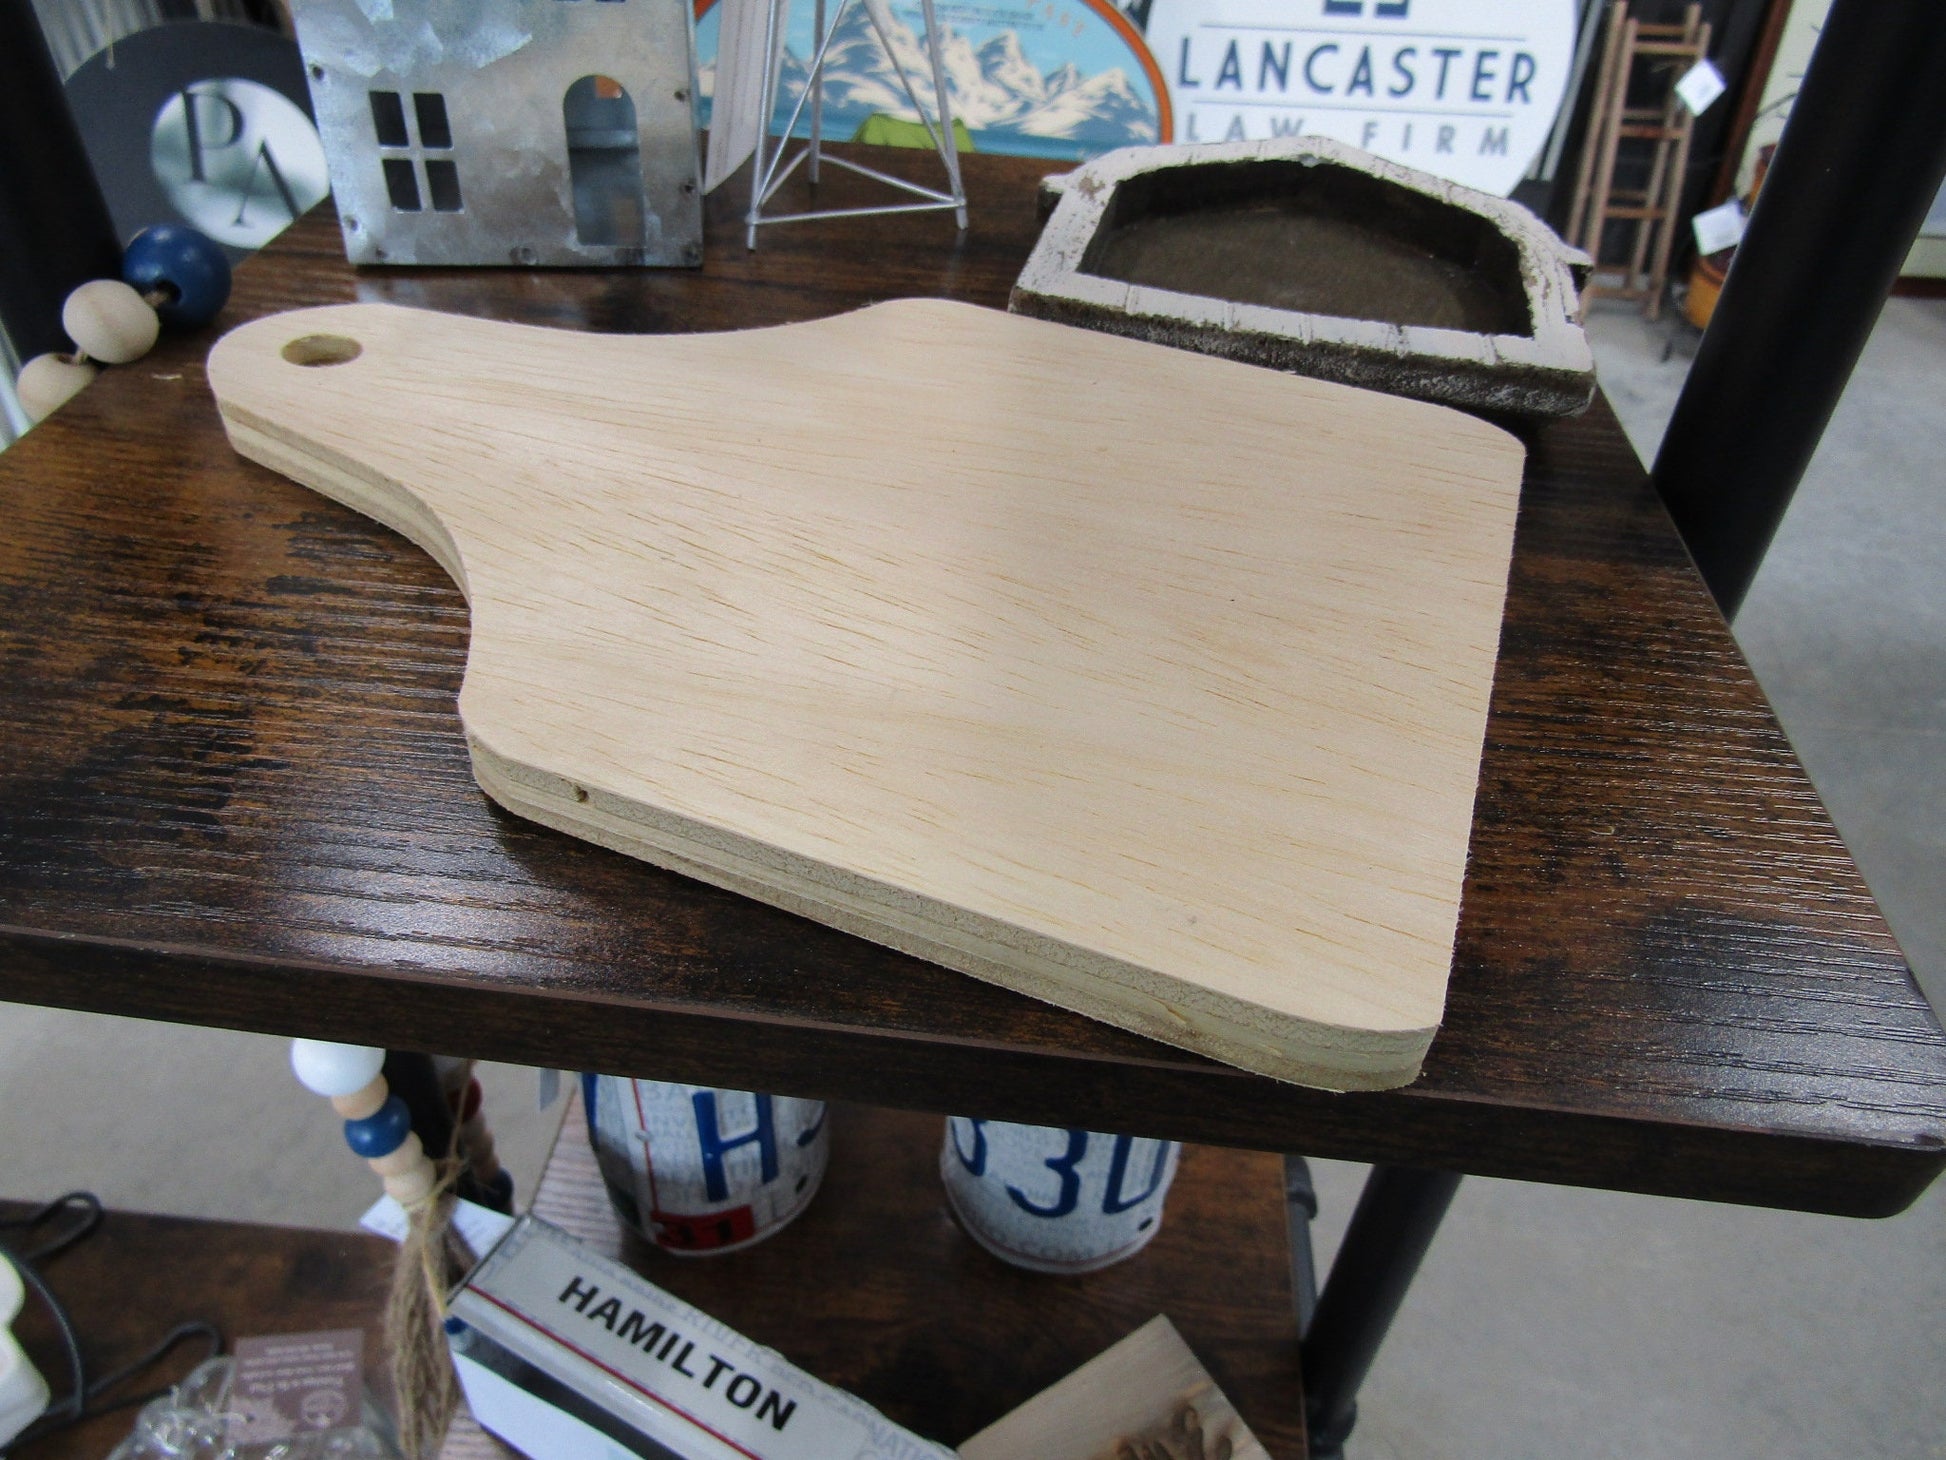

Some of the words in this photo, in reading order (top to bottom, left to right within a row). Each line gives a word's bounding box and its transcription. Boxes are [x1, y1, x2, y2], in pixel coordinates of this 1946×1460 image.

[1178, 36, 1537, 105] LANCASTER
[1185, 112, 1304, 143] LAW
[1360, 120, 1509, 157] FIRM
[557, 1275, 798, 1432] HAMILTON
